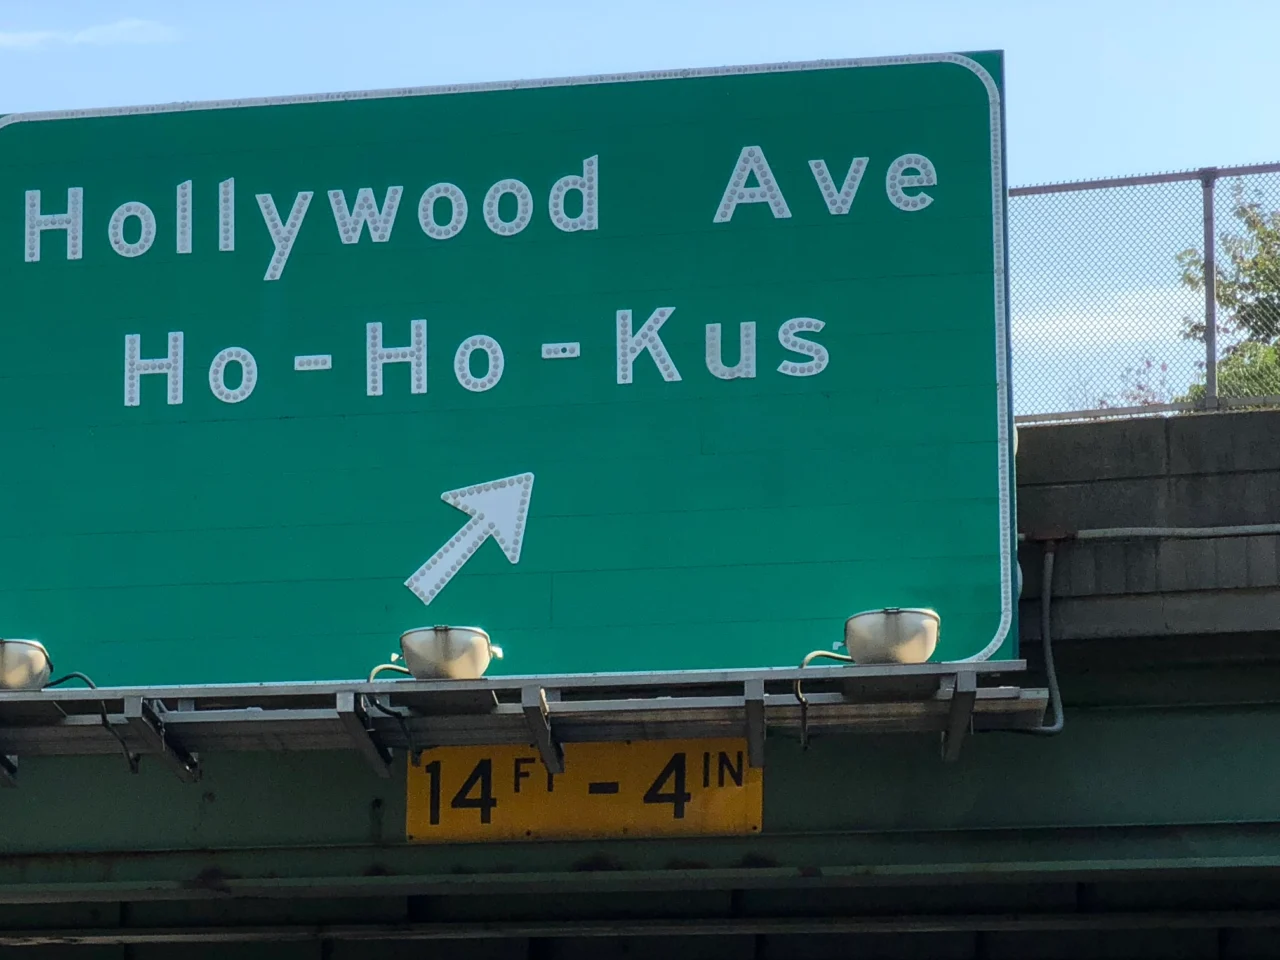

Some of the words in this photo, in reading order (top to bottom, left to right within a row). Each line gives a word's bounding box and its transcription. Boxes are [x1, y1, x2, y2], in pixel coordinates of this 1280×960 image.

[23, 154, 600, 282] Hollywood
[712, 145, 939, 232] Ave
[123, 306, 830, 408] Ho-Ho-Kus
[425, 757, 498, 825] 14
[642, 752, 692, 819] 4
[702, 750, 744, 788] IN
